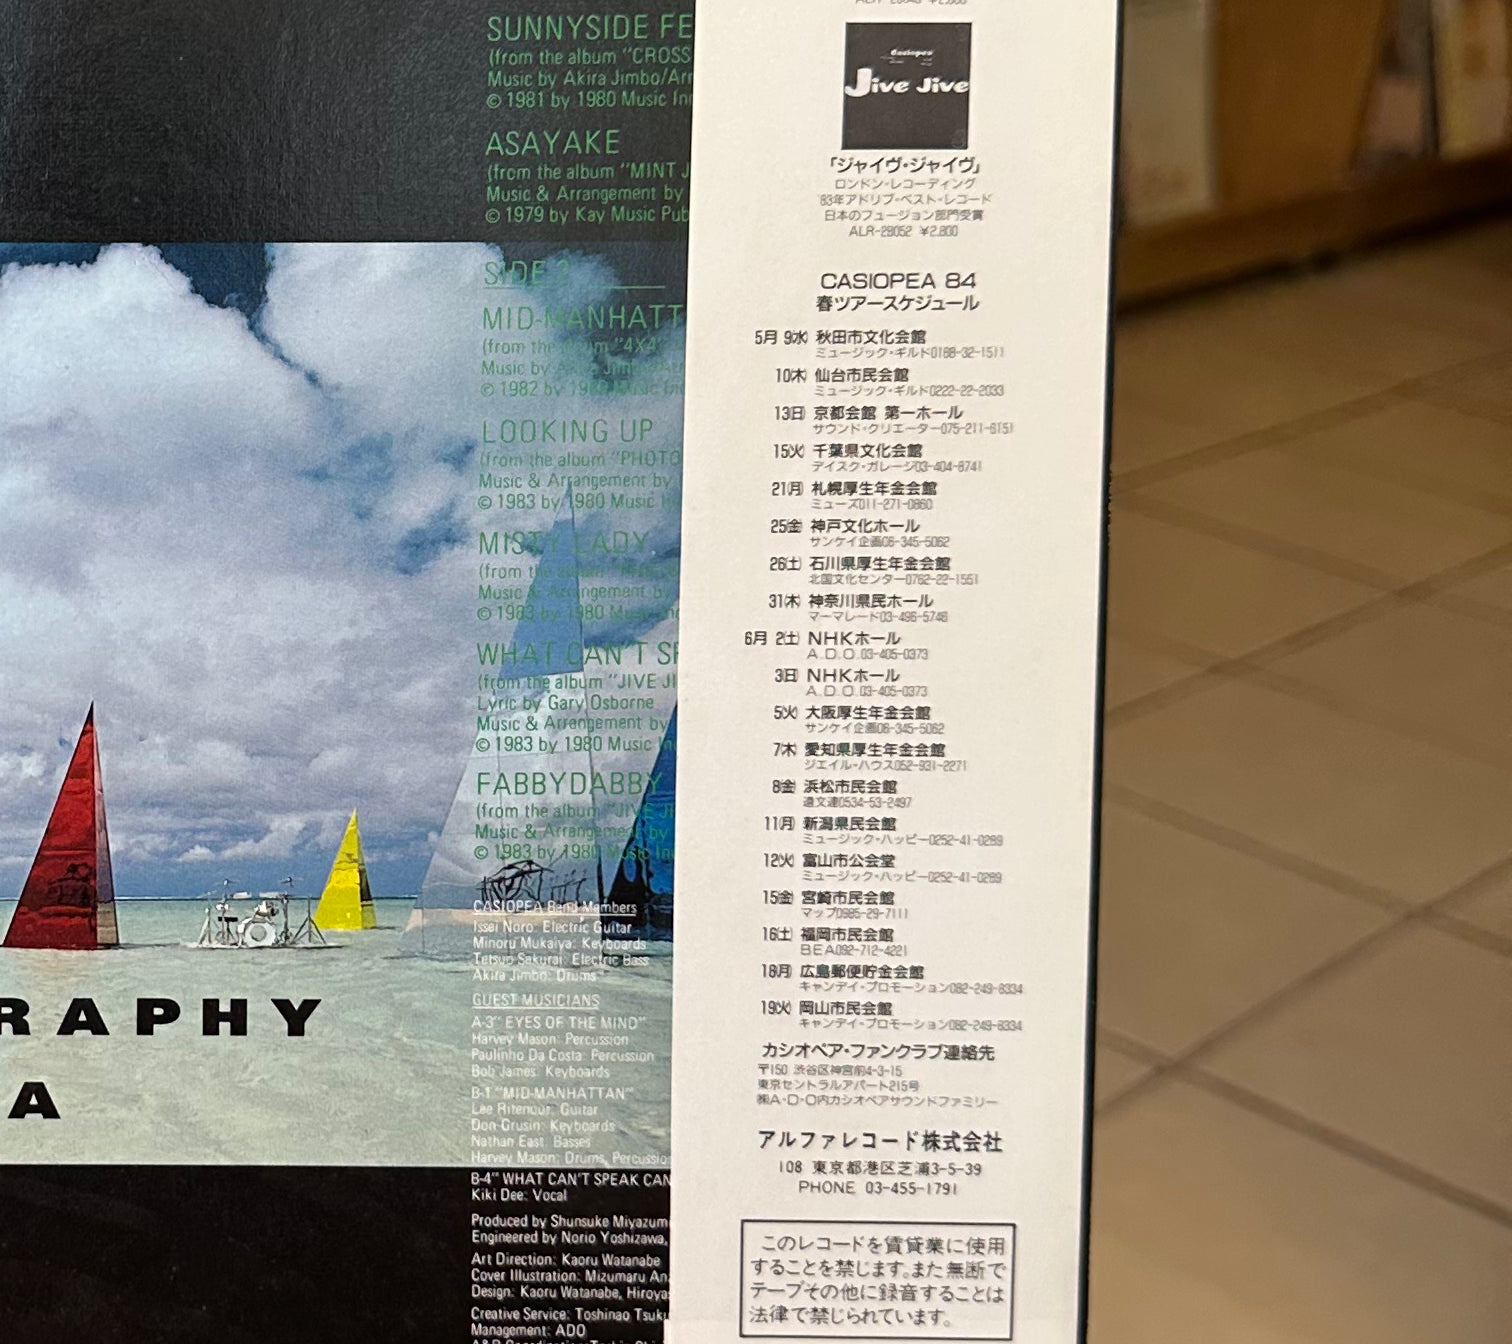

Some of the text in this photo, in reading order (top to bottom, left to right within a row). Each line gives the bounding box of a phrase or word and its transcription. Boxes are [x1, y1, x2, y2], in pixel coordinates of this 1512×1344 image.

[488, 14, 693, 41] SUNNYSIDE FE
[845, 68, 969, 97] Jive Jive
[485, 130, 620, 156] ASAYAKE
[506, 208, 544, 223] 1979
[549, 207, 568, 224] by
[576, 207, 605, 224] Kay
[611, 206, 655, 222] Music
[484, 261, 544, 285] SIDE
[820, 272, 976, 290] CASIOPEA 84
[816, 296, 979, 312] 春ツアースケジュール
[816, 330, 926, 345] 秋田市文化会館
[814, 368, 909, 382] 仙台市民会館
[813, 406, 876, 421] 京都会館
[482, 418, 653, 443] LOOKING UP
[812, 444, 922, 458] 千葉県文化会館
[810, 518, 920, 534] 神戸文化ホール
[479, 531, 650, 555] MISTY LADY
[477, 642, 556, 666] WHAT
[478, 695, 654, 713] Lyric by Gary Osborne
[477, 772, 662, 796] FABBYDABBY
[472, 994, 600, 1006] GUEST MUSICIANS
[758, 1130, 1003, 1152] アルファレコード株式会社
[503, 1172, 543, 1185] WHAT
[594, 1173, 638, 1186] SPEAK
[471, 1188, 496, 1201] Kiki
[533, 1189, 567, 1201] Vocal
[798, 1180, 958, 1195] PHONE 03-455-1791
[471, 1214, 528, 1228] Produced
[532, 1214, 546, 1229] by
[551, 1215, 608, 1228] Shunsuke
[472, 1230, 537, 1246] Engineered
[542, 1230, 557, 1246] by
[561, 1231, 595, 1243] Norio
[471, 1252, 491, 1265] Art
[562, 1253, 598, 1266] Kaoru
[602, 1254, 660, 1267] Watanabe
[471, 1268, 505, 1282] Cover
[585, 1270, 646, 1282] Mizumaru
[520, 1285, 557, 1298] Kaoru
[471, 1307, 519, 1320] Creative
[575, 1307, 630, 1321] Toshinao
[555, 1324, 586, 1337] ADO
